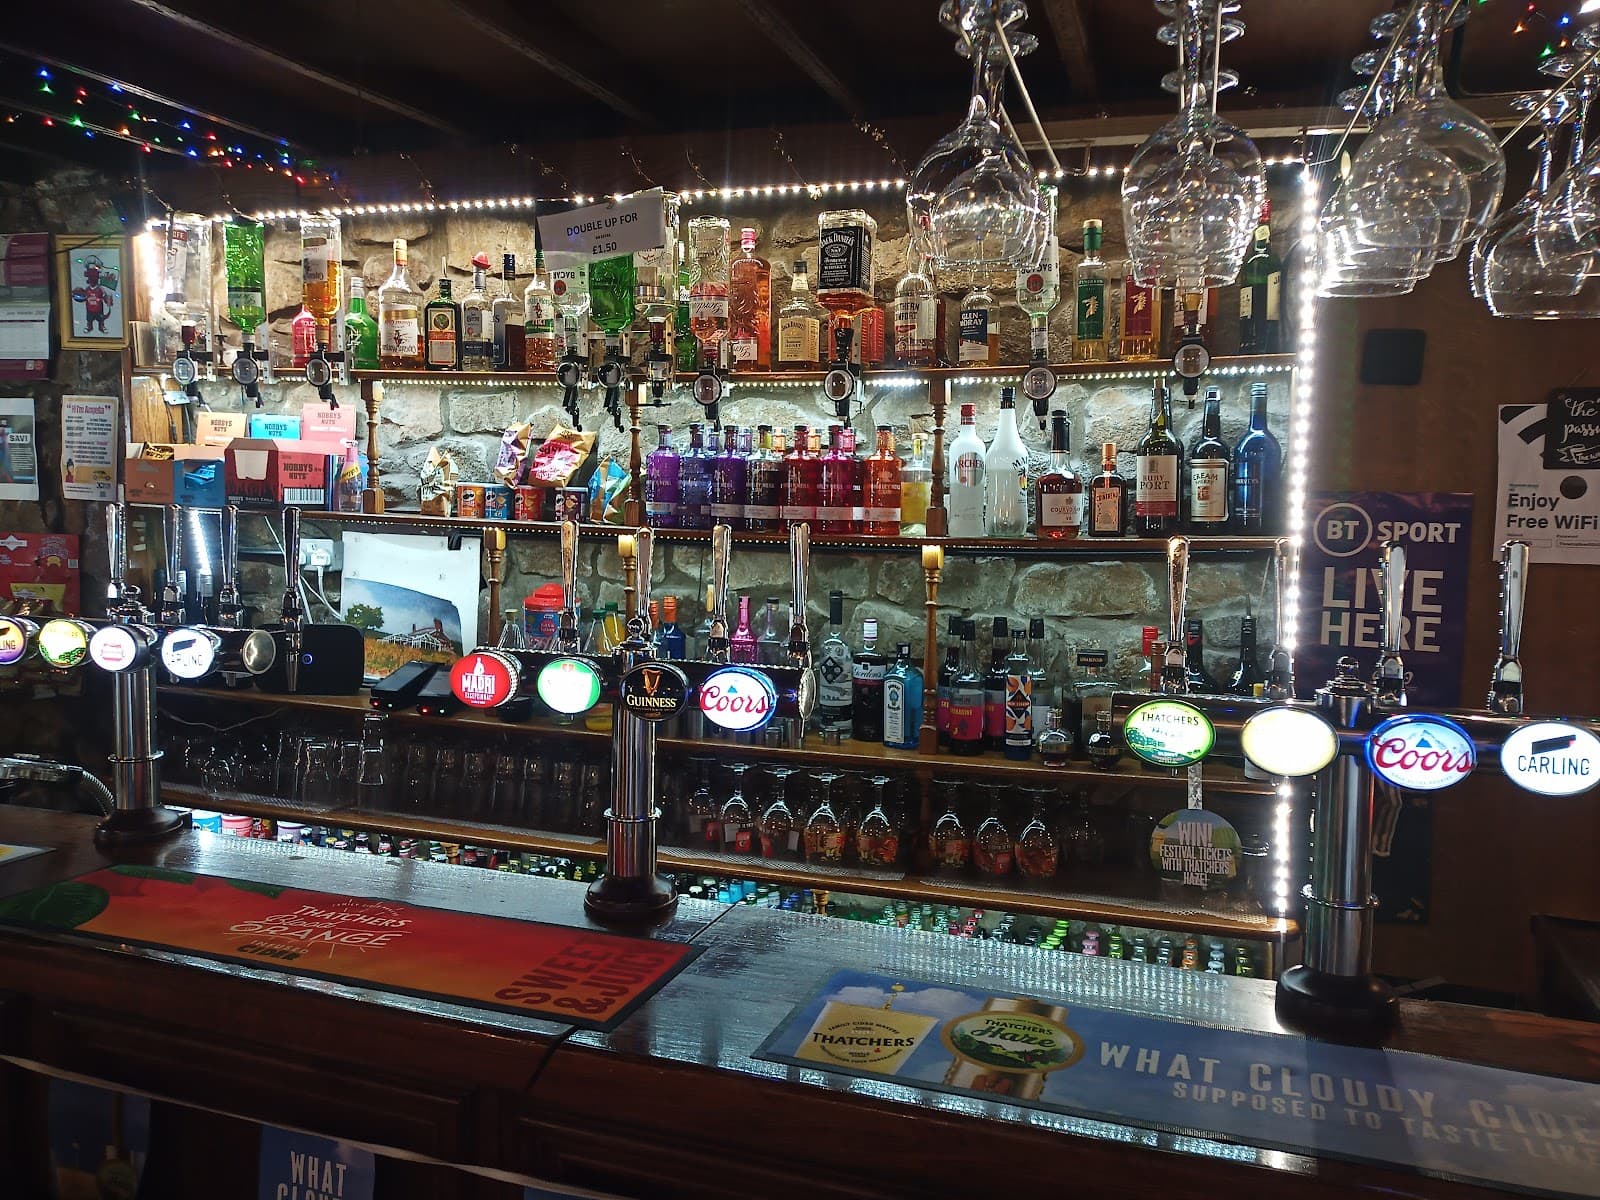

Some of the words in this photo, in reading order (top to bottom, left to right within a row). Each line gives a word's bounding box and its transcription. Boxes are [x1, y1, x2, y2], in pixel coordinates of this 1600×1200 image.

[567, 221, 602, 236] DOUBLE
[605, 217, 617, 228] UP
[620, 213, 638, 225] FOR
[592, 242, 617, 255] £1.50
[1565, 398, 1599, 417] the
[283, 463, 313, 472] NOBBYS
[1140, 481, 1170, 490] PORT
[1508, 493, 1560, 511] Enjoy
[1326, 519, 1361, 540] BT
[1376, 521, 1462, 544] SPORT
[1506, 514, 1549, 529] Free
[1554, 515, 1598, 530] WiFi
[626, 695, 677, 708] GUINNESS
[699, 684, 769, 714] Coors
[1141, 712, 1199, 726] THATCHERS
[1373, 736, 1473, 773] Coors
[1517, 754, 1590, 776] CARLING
[1178, 822, 1213, 847] WIN!
[1160, 844, 1196, 859] FESTIVAL
[1198, 847, 1232, 861] TICKETS
[1161, 857, 1182, 871] WITH
[1184, 859, 1230, 874] THATCHERS
[294, 905, 413, 928] THATCHERS
[230, 921, 402, 946] ORANGE
[970, 1025, 1057, 1048] Haze
[985, 1019, 1053, 1036] THATCHERS
[813, 1032, 915, 1046] THATCHERS
[1101, 1041, 1220, 1083] WHAT
[1250, 1063, 1434, 1118] CLOUDY
[1173, 1082, 1326, 1121] SUPPOSED
[1344, 1107, 1382, 1130] TO
[1400, 1117, 1503, 1151] TASTE
[290, 1150, 347, 1197] WHAT
